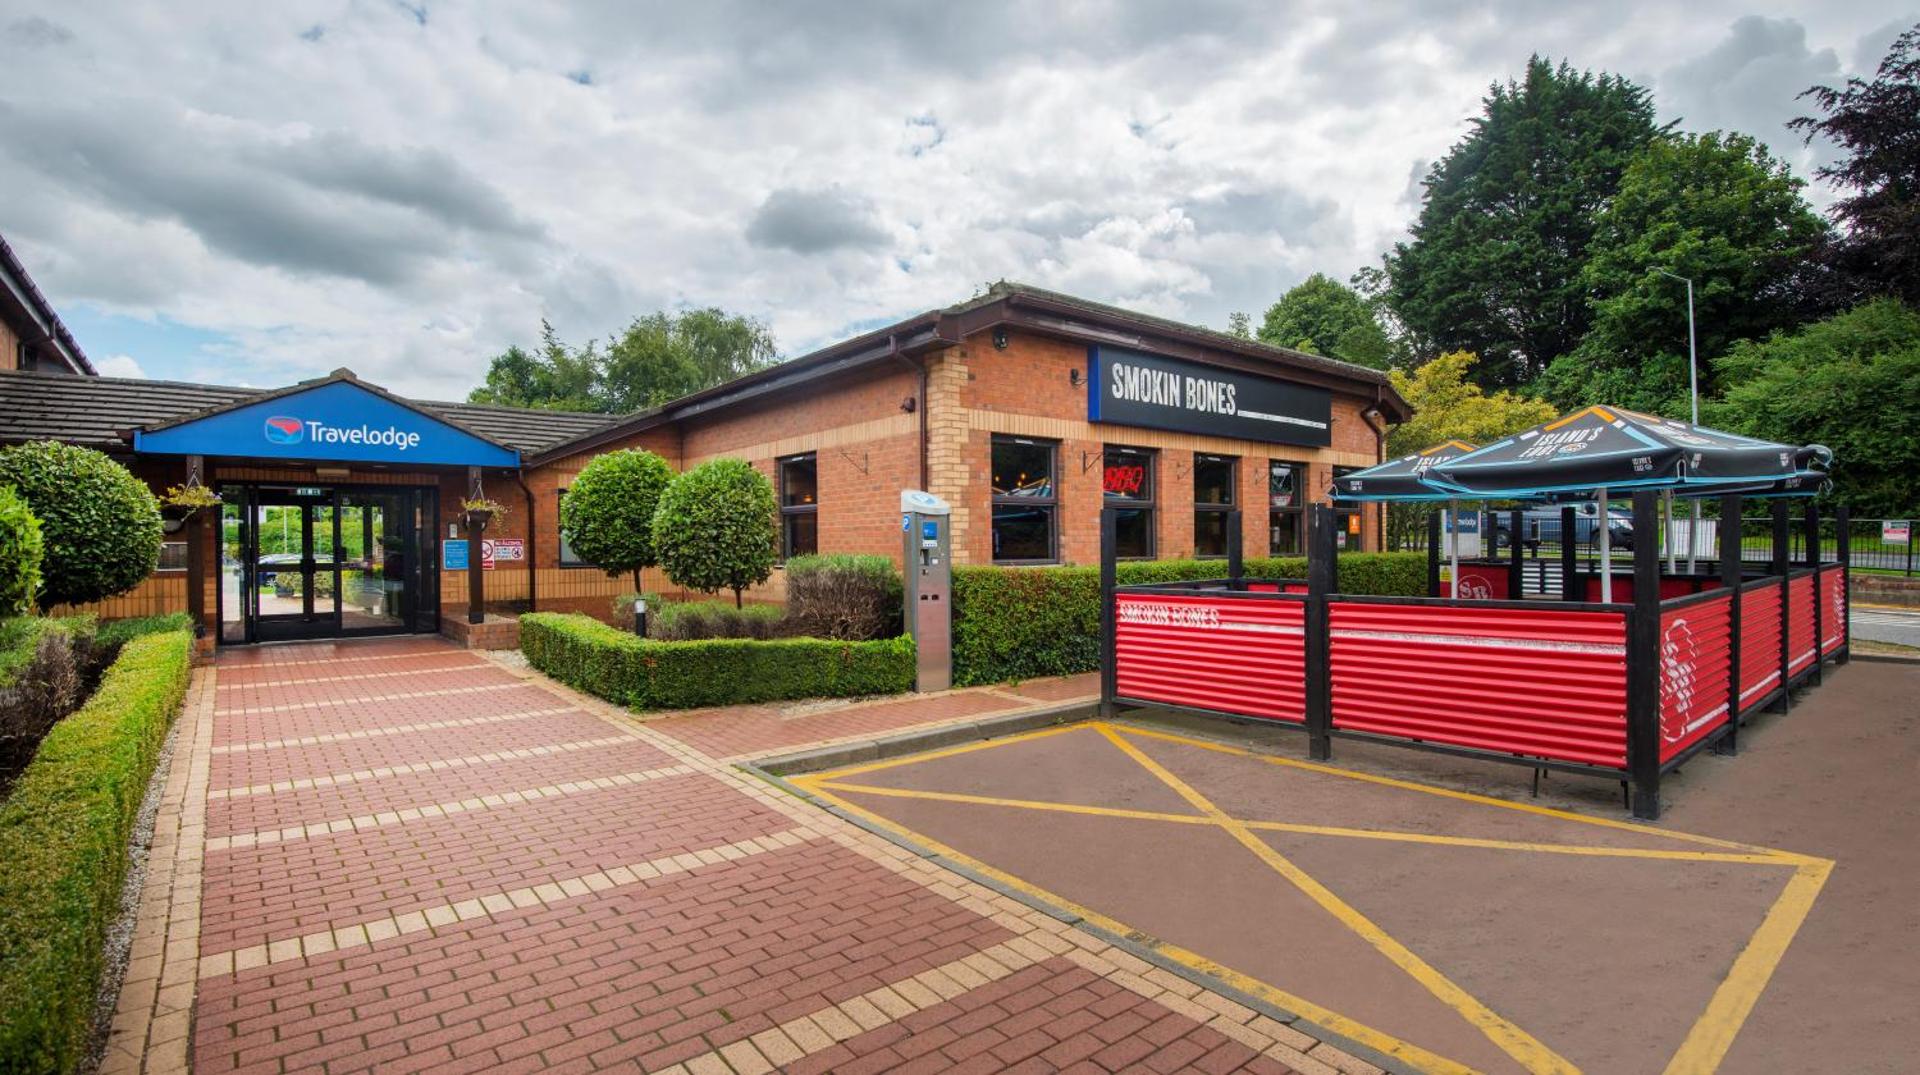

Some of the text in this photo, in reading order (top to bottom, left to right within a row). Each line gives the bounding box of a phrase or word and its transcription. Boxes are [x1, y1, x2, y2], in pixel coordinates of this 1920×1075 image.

[1111, 363, 1236, 416] SMOKIN BONES
[306, 421, 420, 450] Travelodge
[1533, 426, 1604, 446] ISLAND'S
[1103, 465, 1143, 493] BBQ
[1119, 601, 1219, 629] SMOKIN BONES
